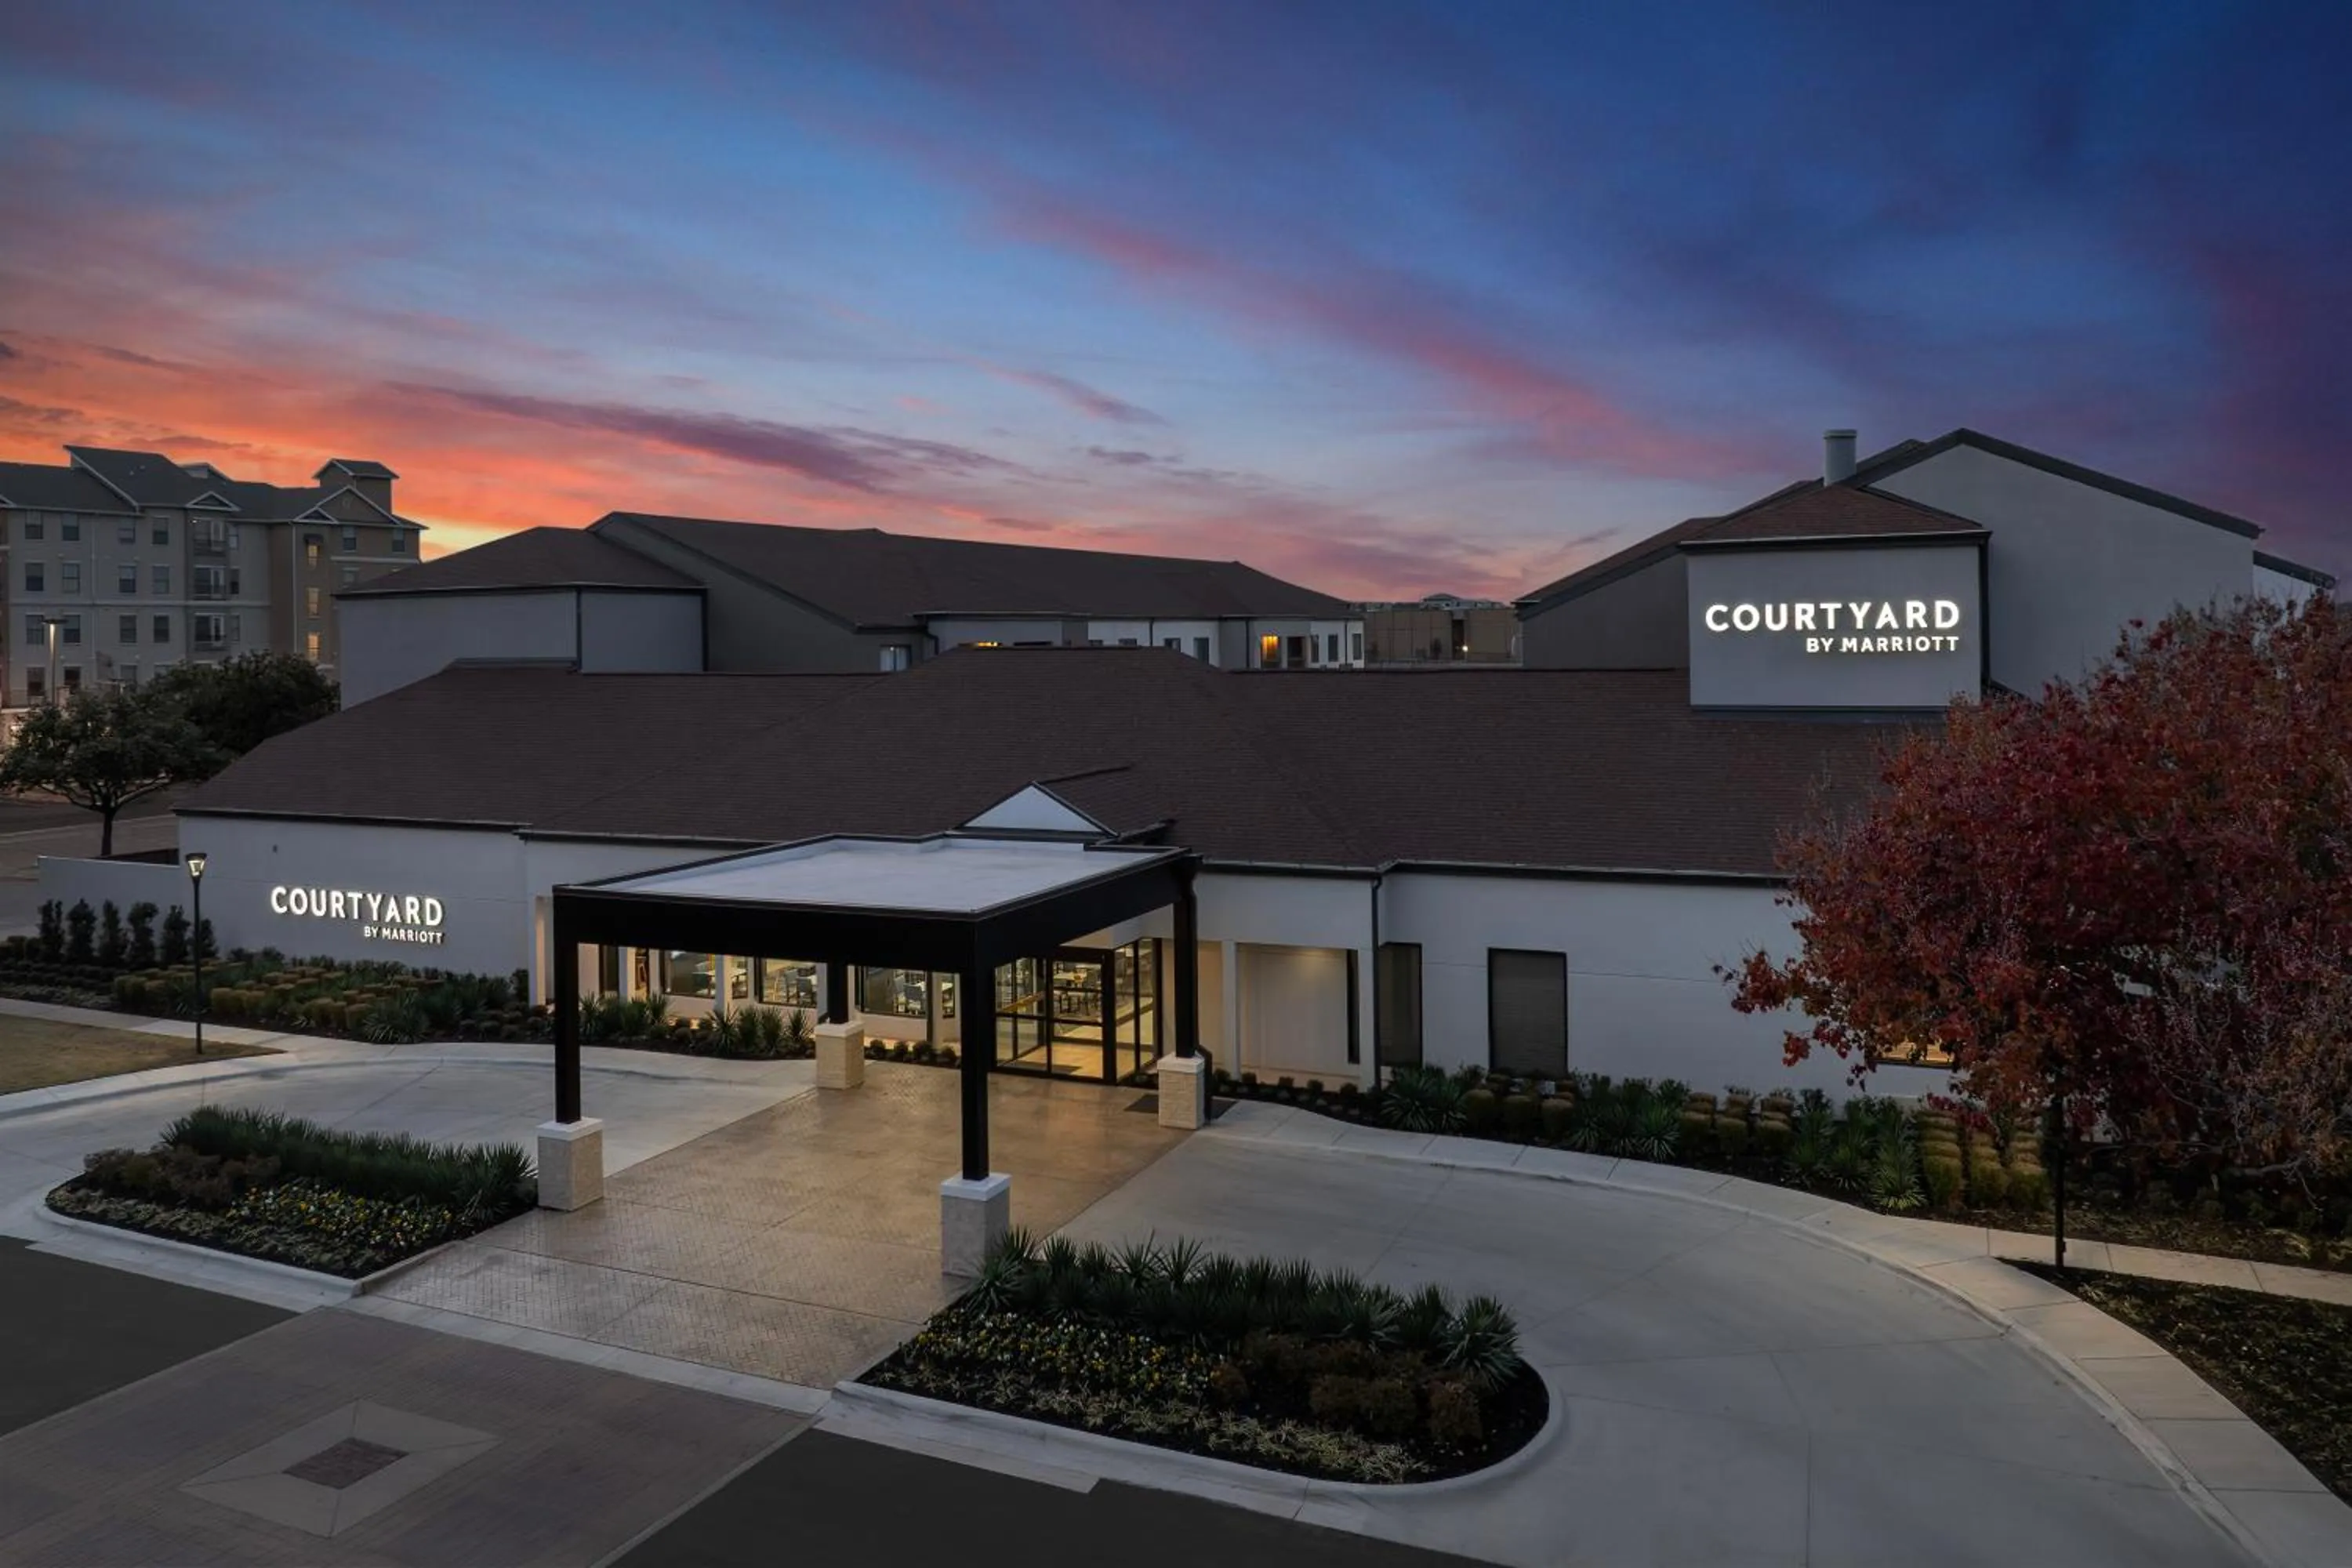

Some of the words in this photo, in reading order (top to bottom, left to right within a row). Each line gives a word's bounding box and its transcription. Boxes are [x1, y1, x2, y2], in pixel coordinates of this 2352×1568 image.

[1704, 601, 1959, 632] COURTYARD
[1806, 637, 1834, 653] BY
[1839, 636, 1959, 652] MARRIOTT
[270, 886, 444, 926] COURTYARD
[364, 926, 379, 938] BY
[382, 927, 443, 945] MARRIOTT
